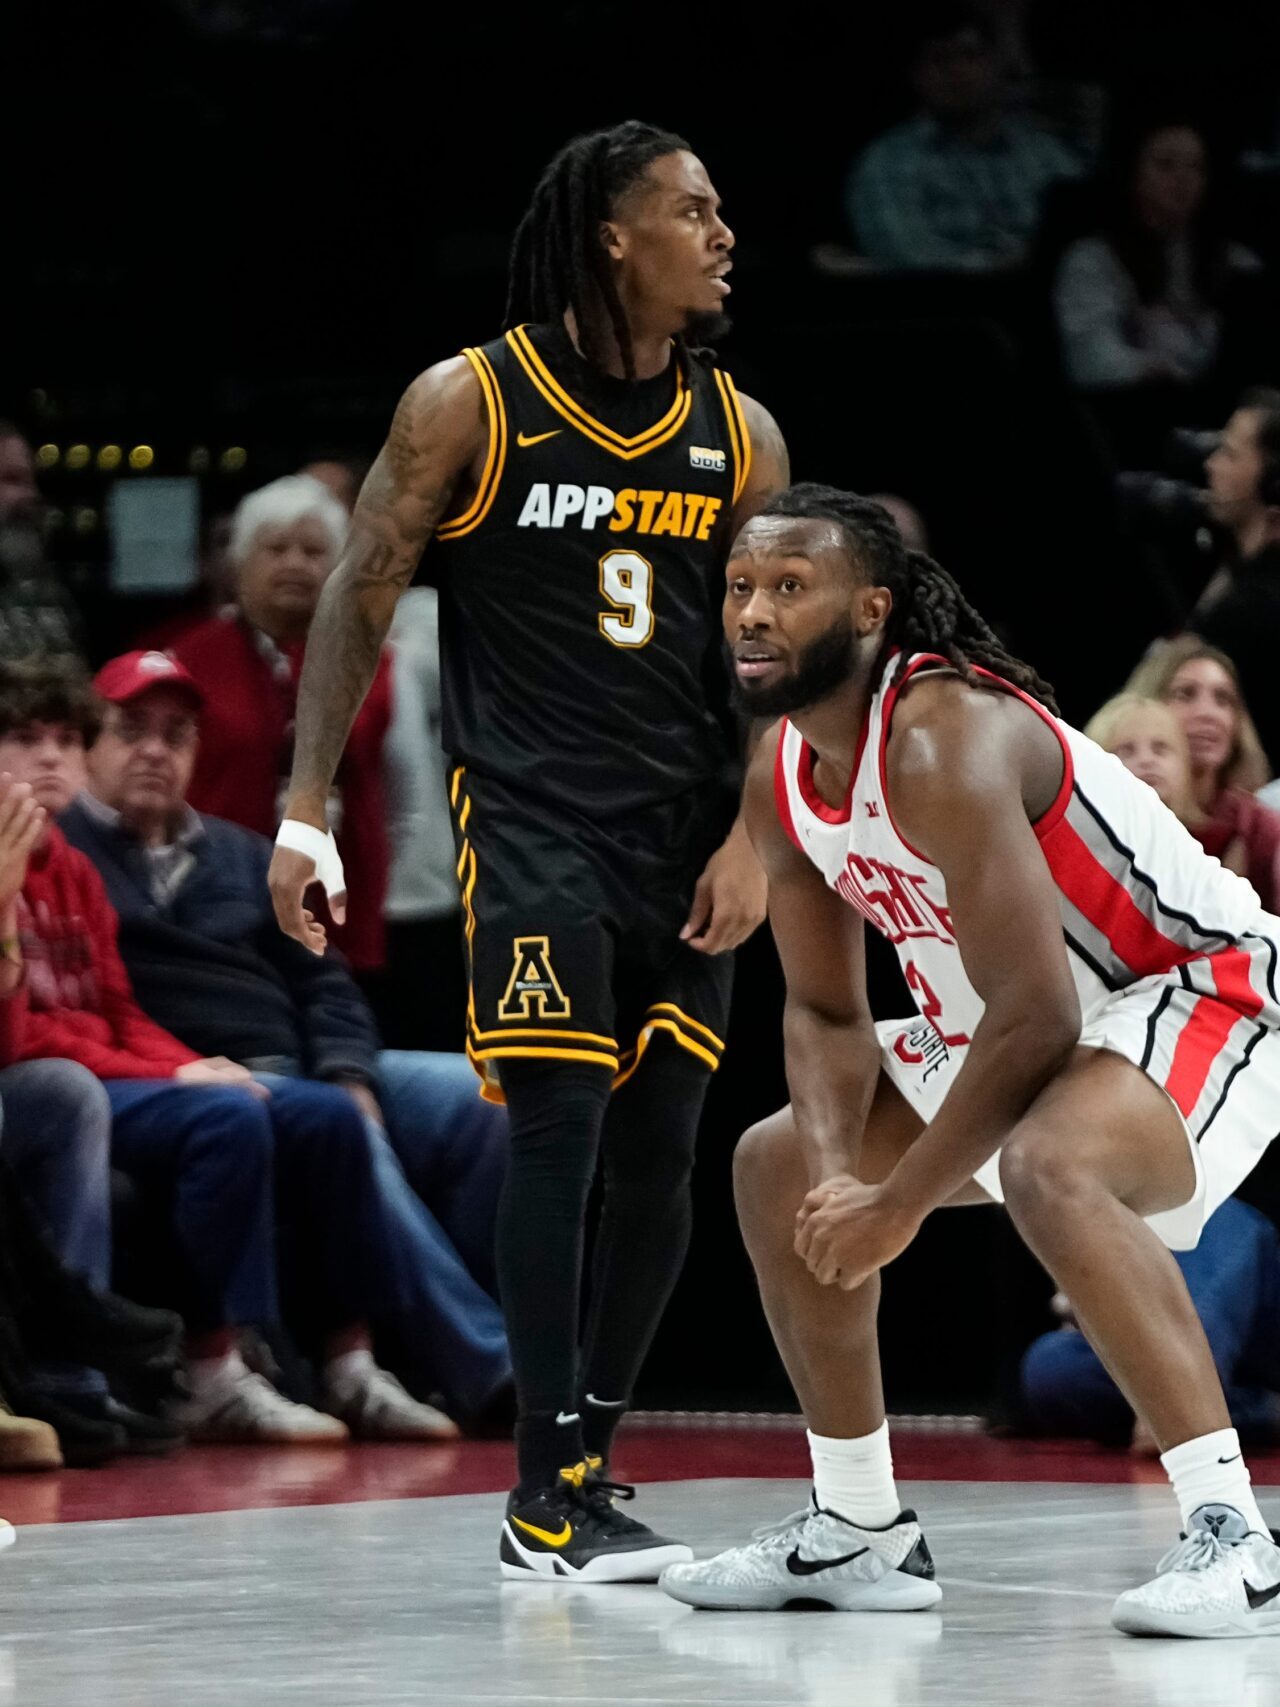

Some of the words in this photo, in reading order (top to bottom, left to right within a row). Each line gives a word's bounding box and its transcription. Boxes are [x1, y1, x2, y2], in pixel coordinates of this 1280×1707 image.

[598, 549, 655, 649] 9
[498, 935, 571, 1020] A
[904, 959, 972, 1047] 2
